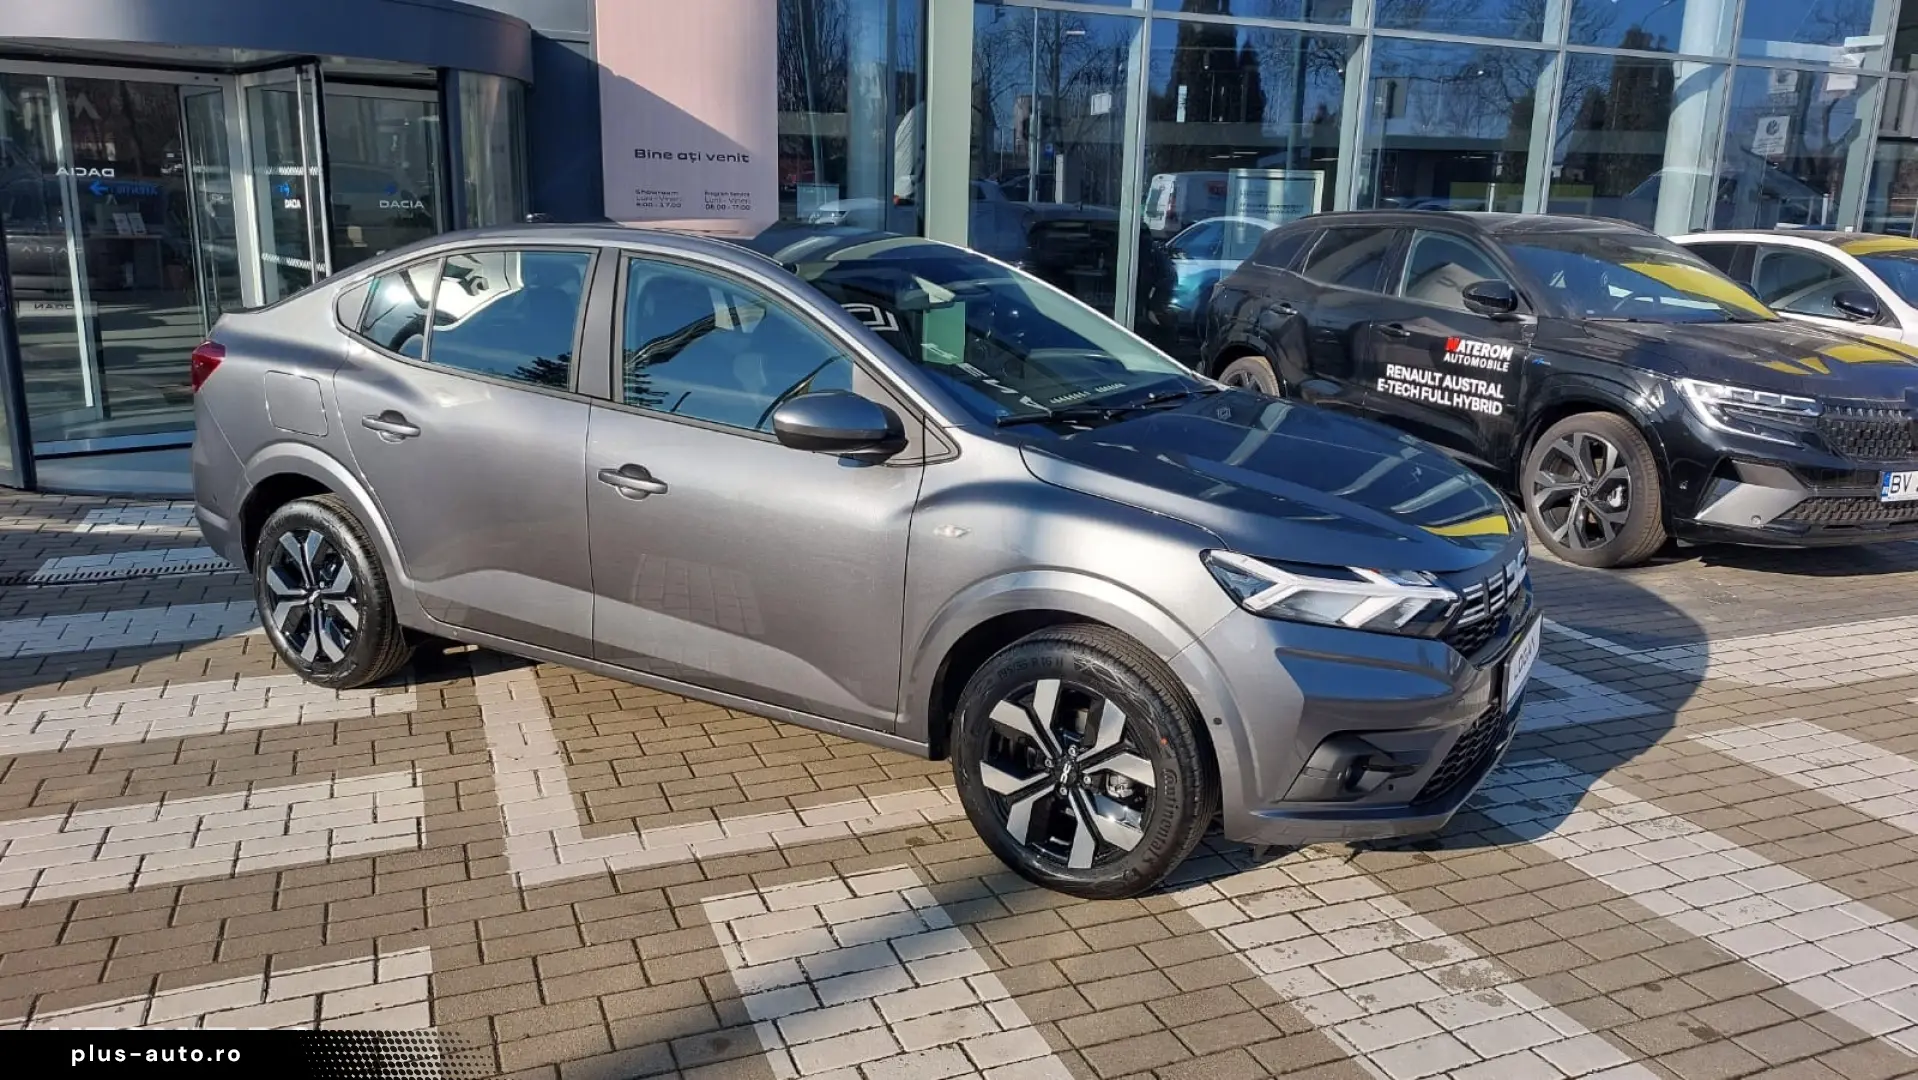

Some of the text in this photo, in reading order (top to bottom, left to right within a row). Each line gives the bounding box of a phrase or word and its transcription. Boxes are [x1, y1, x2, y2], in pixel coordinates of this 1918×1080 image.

[634, 148, 674, 160] Bine
[705, 152, 750, 164] venit
[379, 199, 425, 209] DACIA
[1444, 353, 1511, 373] AUTOMOBILE
[1385, 364, 1505, 399] RENAULT AUSTRAL
[1376, 378, 1503, 416] E-TECH FULL HYBRID
[1890, 473, 1913, 494] BV
